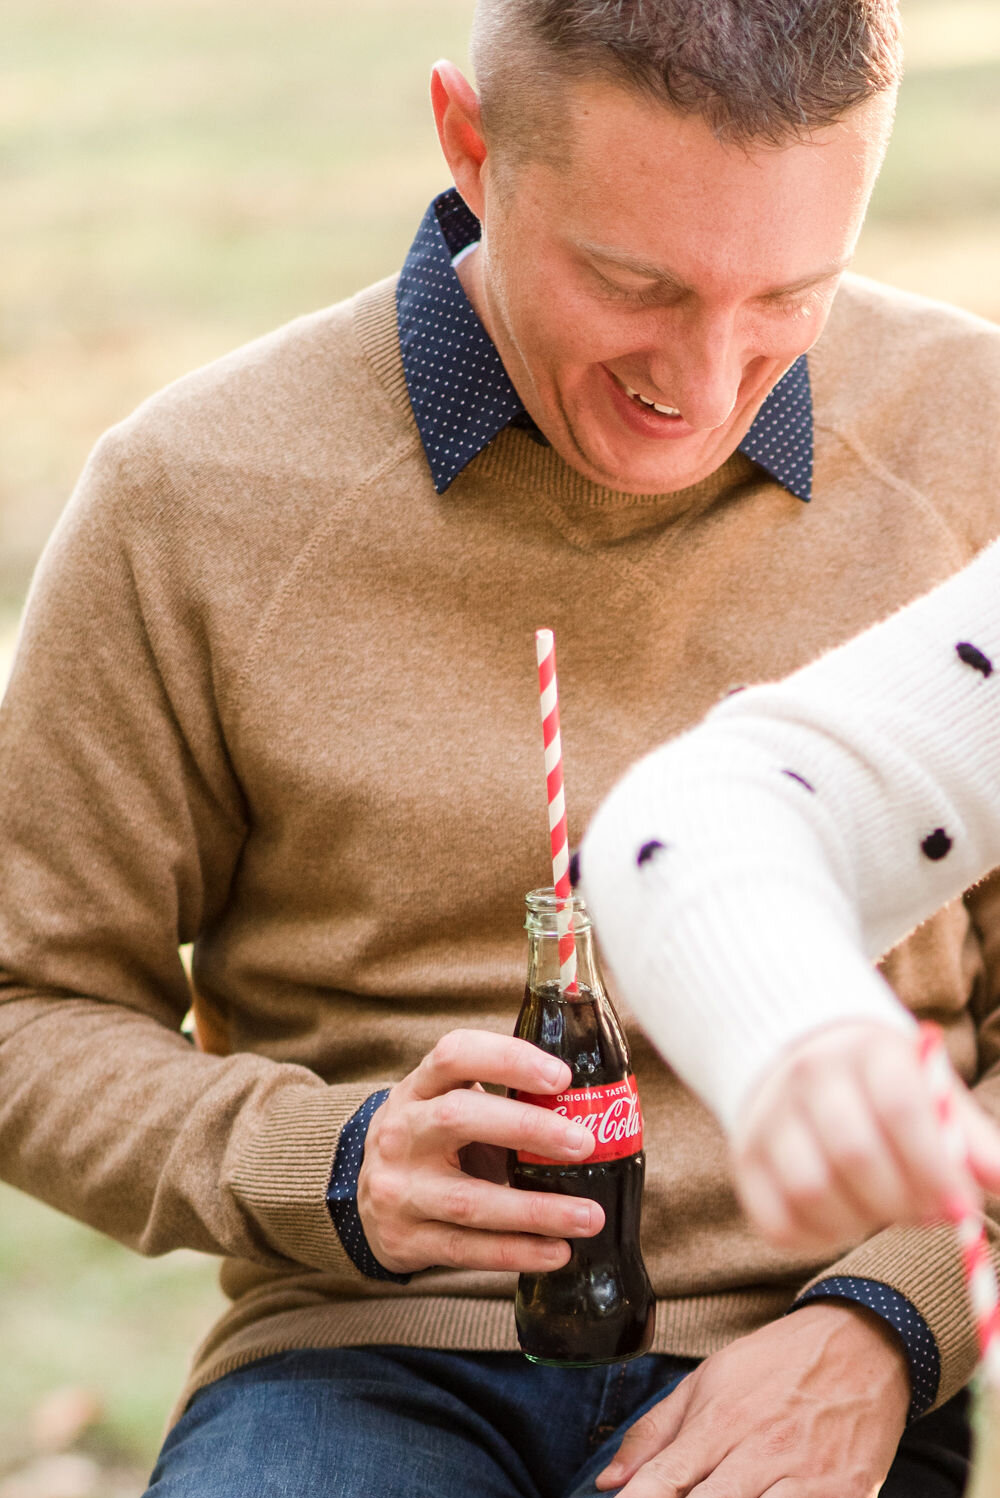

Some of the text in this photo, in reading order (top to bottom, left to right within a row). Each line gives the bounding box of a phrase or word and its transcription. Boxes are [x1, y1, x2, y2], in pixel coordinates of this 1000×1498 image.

[556, 1085, 628, 1102] ORIGINAL TASTE
[553, 1092, 640, 1144] ca-Cola
